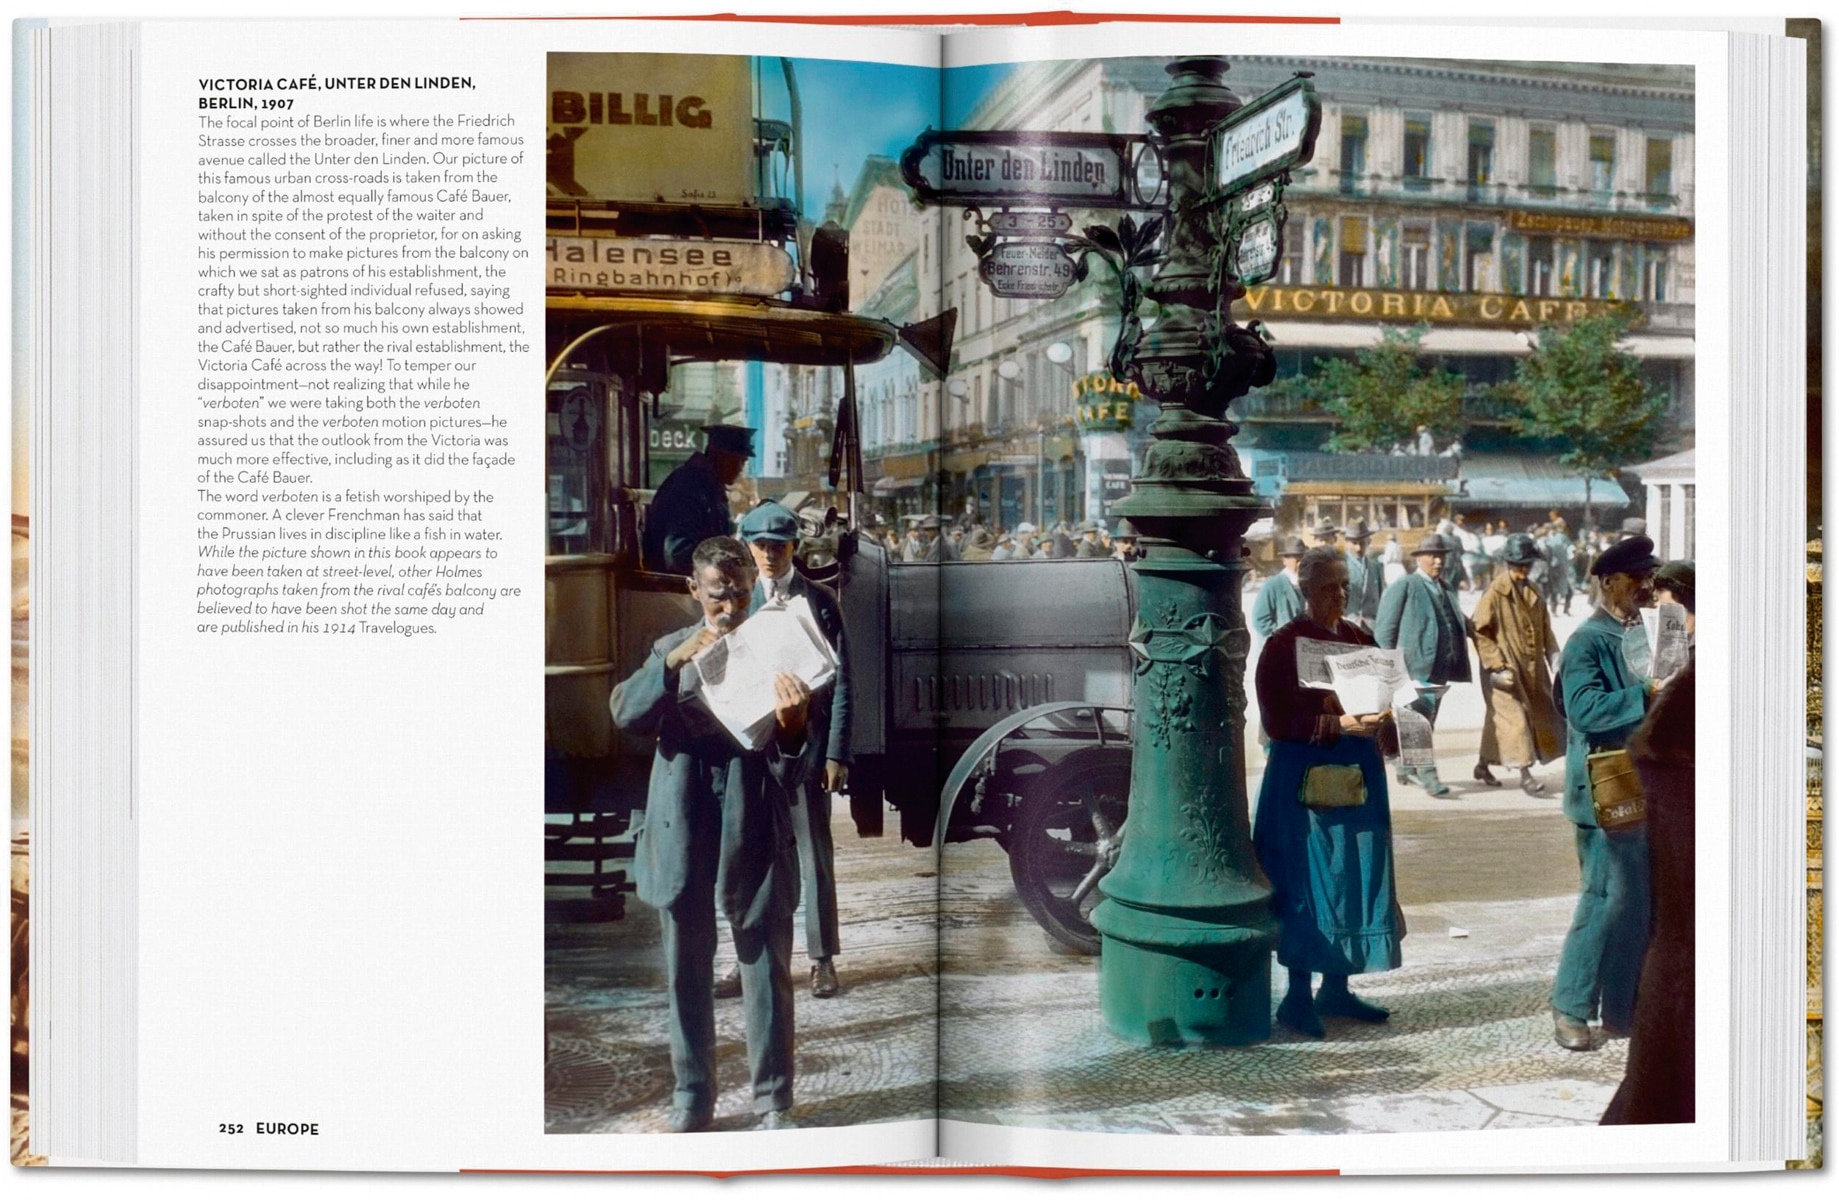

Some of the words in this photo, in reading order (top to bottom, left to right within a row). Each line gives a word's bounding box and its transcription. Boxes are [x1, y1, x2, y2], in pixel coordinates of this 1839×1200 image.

[198, 78, 274, 91] VICTORIA
[276, 73, 322, 92] CAFÉ,
[324, 77, 376, 90] UNTER
[379, 76, 411, 90] DEN
[414, 76, 476, 91] LINDEN,
[198, 96, 258, 111] BERLIN,
[261, 98, 294, 111] 1907
[551, 90, 713, 129] BILLIG
[198, 115, 223, 128] The
[226, 114, 257, 128] focal
[261, 116, 294, 131] point
[297, 114, 310, 128] of
[314, 114, 351, 128] Berlin
[354, 114, 374, 128] life
[377, 116, 387, 128] is
[389, 114, 430, 127] where
[433, 114, 454, 127] the
[458, 113, 515, 127] Friedrich
[198, 134, 245, 147] Strasse
[248, 138, 297, 147] crosses
[300, 133, 322, 146] the
[324, 132, 378, 147] broader,
[382, 132, 411, 146] finer
[414, 132, 438, 146] and
[441, 136, 475, 146] more
[478, 132, 524, 146] famous
[1225, 117, 1272, 170] Friedrich
[1274, 108, 1295, 143] Str.
[942, 149, 996, 181] Unter
[1001, 149, 1035, 181] den
[1040, 151, 1105, 184] Linden
[198, 190, 249, 206] balcony
[252, 189, 266, 203] of
[268, 190, 289, 203] the
[292, 189, 334, 203] almost
[338, 189, 384, 206] equally
[387, 188, 434, 202] famous
[436, 188, 468, 202] Café
[472, 189, 511, 203] Bauer,
[1008, 215, 1018, 228] 3
[1037, 215, 1057, 229] 25
[198, 227, 246, 240] without
[250, 227, 272, 240] the
[274, 229, 326, 240] consent
[329, 226, 342, 240] of
[345, 226, 366, 240] the
[369, 228, 438, 243] proprietor,
[441, 226, 459, 240] for
[461, 231, 478, 240] on
[482, 226, 522, 243] asking
[987, 261, 1052, 277] Behrenstr.
[1054, 263, 1070, 278] 49
[198, 283, 234, 300] crafty
[238, 283, 260, 296] but
[263, 283, 347, 300] short-sighted
[351, 283, 412, 296] individual
[415, 282, 467, 297] refused,
[470, 284, 510, 300] saying
[198, 302, 224, 316] that
[226, 304, 279, 318] pictures
[282, 302, 318, 316] taken
[321, 302, 351, 316] from
[354, 302, 372, 316] his
[375, 302, 425, 318] balcony
[428, 302, 471, 318] always
[474, 302, 524, 315] showed
[1245, 286, 1455, 319] VICTORIA
[198, 320, 222, 334] and
[225, 320, 296, 335] advertised,
[300, 322, 321, 334] not
[325, 325, 340, 334] so
[343, 320, 378, 334] much
[381, 320, 399, 334] his
[402, 325, 429, 334] own
[432, 320, 525, 334] establishment,
[198, 358, 248, 372] Victoria
[251, 358, 282, 372] Café
[285, 362, 327, 372] across
[330, 358, 352, 371] the
[354, 358, 383, 374] way!
[386, 358, 402, 372] To
[404, 360, 452, 374] temper
[454, 362, 476, 372] our
[198, 452, 232, 465] much
[236, 456, 269, 465] more
[272, 451, 332, 466] effective,
[335, 452, 393, 469] including
[396, 456, 410, 465] as
[412, 453, 420, 465] it
[424, 452, 445, 466] did
[448, 452, 469, 466] the
[472, 452, 516, 469] façade
[197, 512, 268, 521] commoner.
[272, 508, 282, 520] A
[285, 508, 325, 521] clever
[328, 508, 400, 521] Frenchman
[404, 508, 426, 521] has
[428, 508, 454, 522] said
[458, 508, 482, 522] that
[197, 563, 228, 577] have
[232, 564, 264, 577] been
[267, 564, 302, 577] taken
[306, 566, 319, 577] at
[322, 564, 394, 578] street-level,
[398, 564, 432, 578] other
[436, 565, 482, 578] Holmes
[197, 600, 253, 614] believed
[255, 603, 268, 614] to
[271, 601, 302, 615] have
[306, 601, 337, 615] been
[340, 601, 367, 615] shot
[371, 602, 391, 615] the
[394, 606, 428, 616] same
[431, 602, 456, 619] day
[459, 602, 485, 616] and
[196, 624, 218, 633] are
[220, 619, 285, 636] published
[287, 621, 298, 633] in
[302, 620, 319, 634] his
[323, 623, 356, 634] 1914
[359, 620, 437, 638] Travelogues.
[218, 1123, 244, 1135] 252
[256, 1122, 319, 1135] EUROPE
